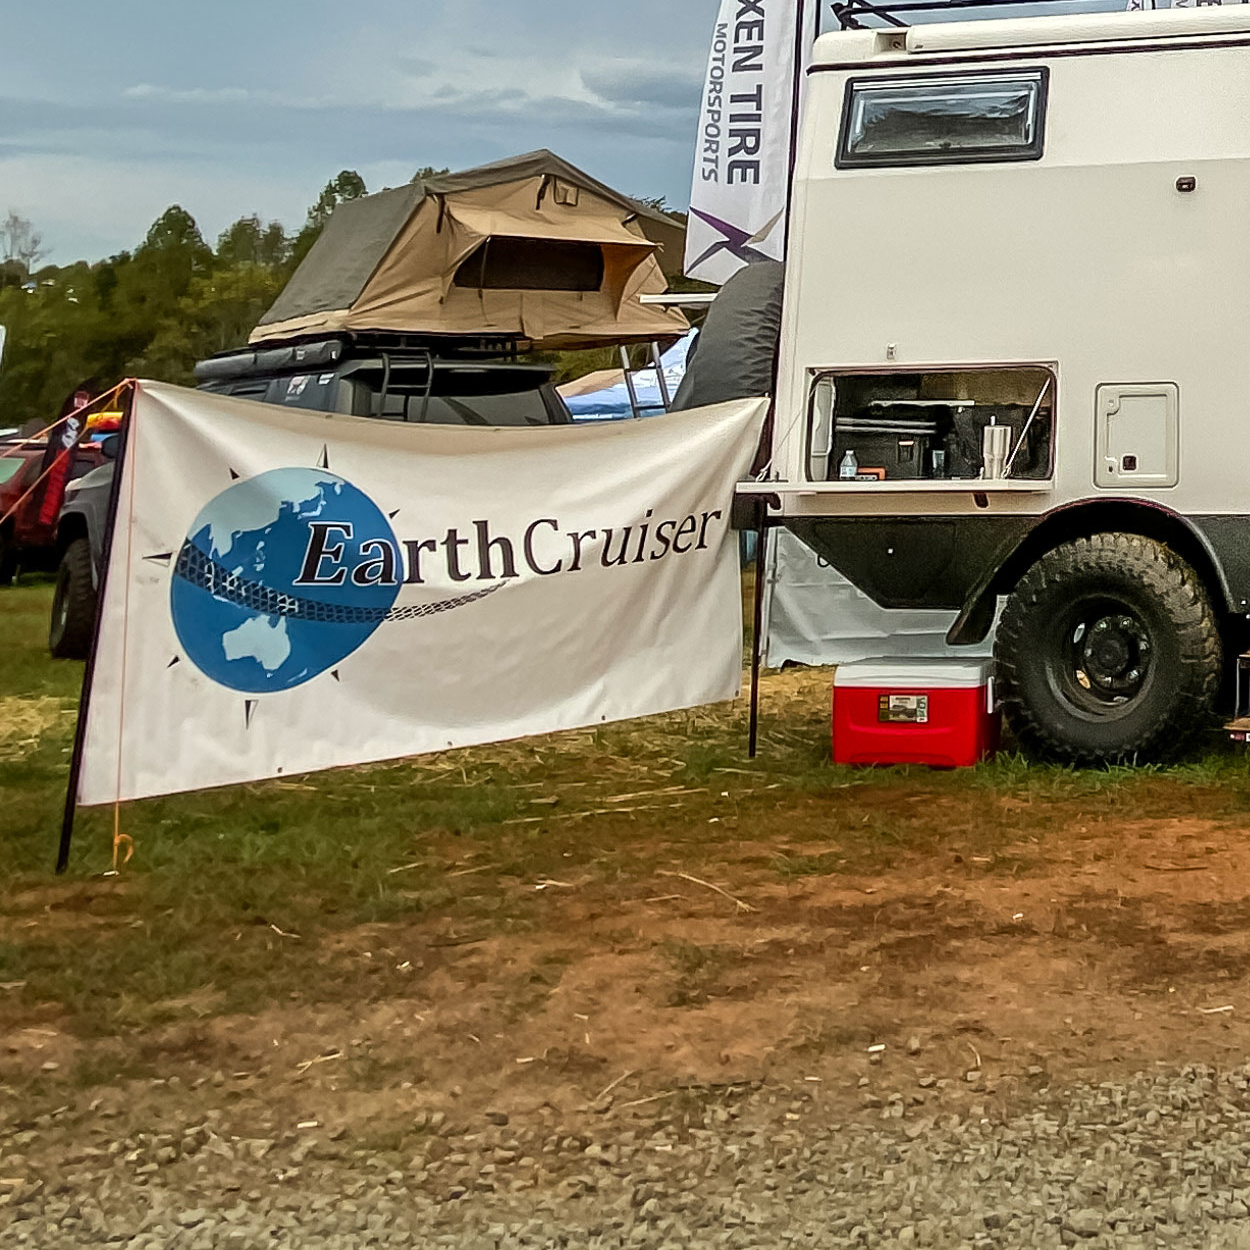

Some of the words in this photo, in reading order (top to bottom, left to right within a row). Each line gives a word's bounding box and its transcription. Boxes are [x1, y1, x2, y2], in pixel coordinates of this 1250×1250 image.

[701, 22, 729, 183] MOTORSPORTS
[726, 83, 763, 185] TIRE
[293, 508, 722, 587] EarthCruiser
